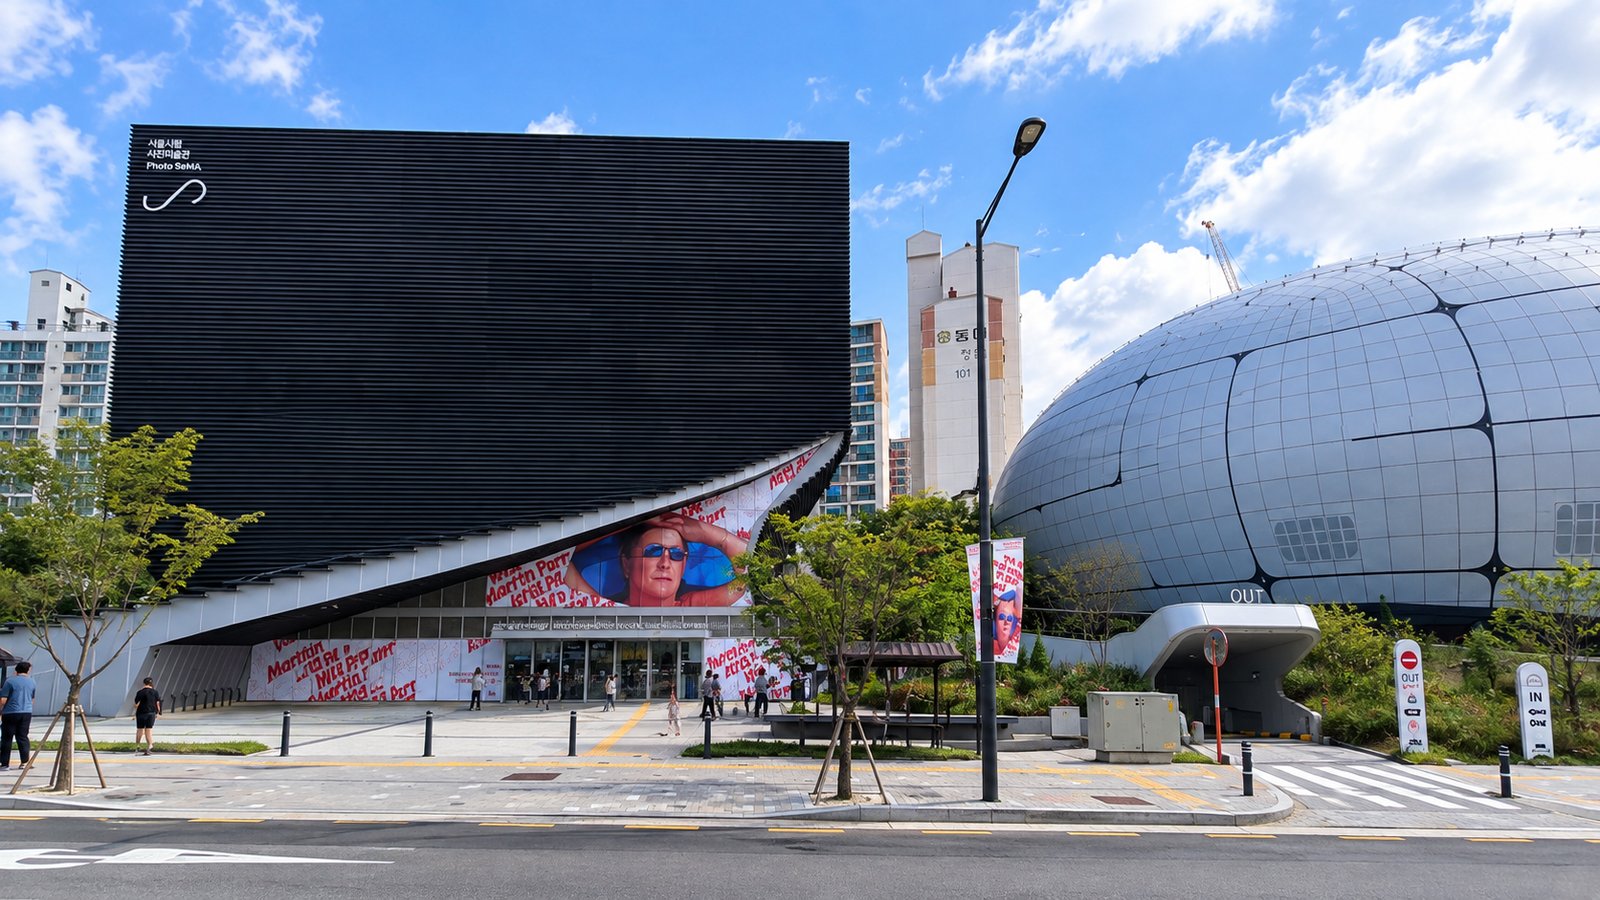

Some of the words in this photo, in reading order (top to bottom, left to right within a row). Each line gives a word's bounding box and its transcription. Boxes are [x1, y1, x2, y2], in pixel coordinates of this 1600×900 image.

[146, 162, 173, 170] Photo
[174, 162, 202, 171] SeMA
[956, 369, 970, 378] 101
[1230, 588, 1264, 604] OUT
[1402, 673, 1419, 682] OUT
[1530, 692, 1542, 702] IN
